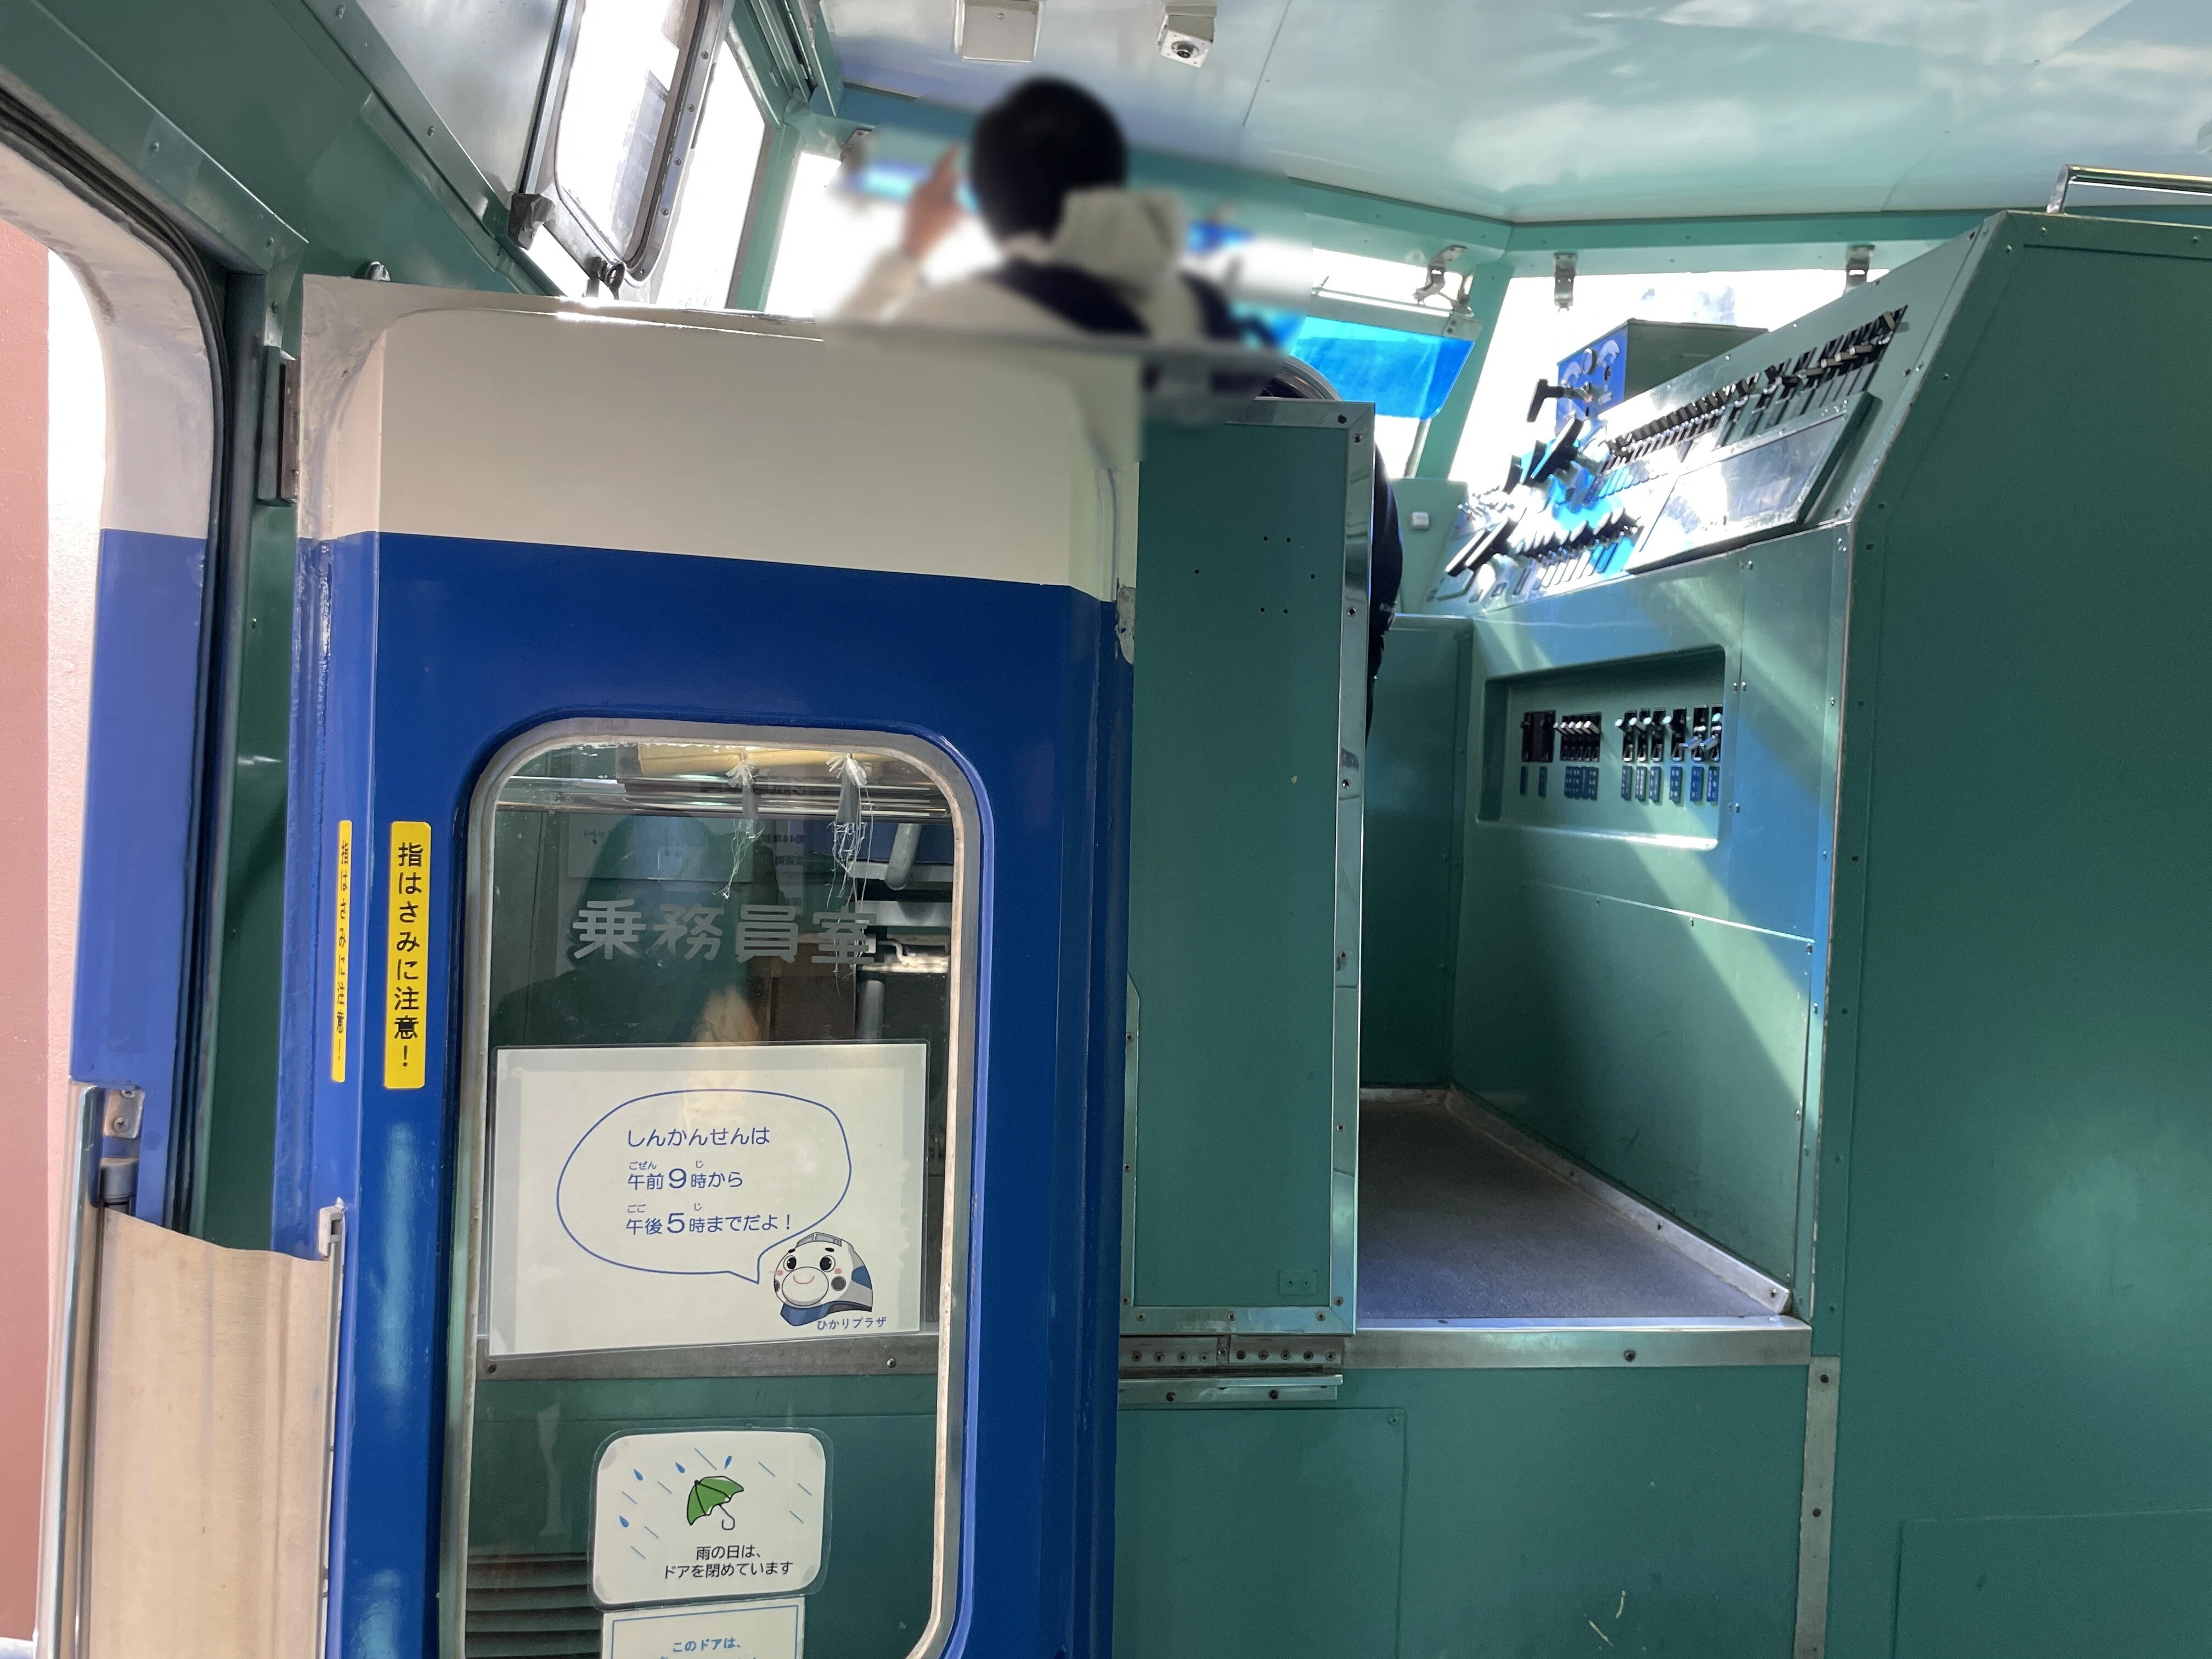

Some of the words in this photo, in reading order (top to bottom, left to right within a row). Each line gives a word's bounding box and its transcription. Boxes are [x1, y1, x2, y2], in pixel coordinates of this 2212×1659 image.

[572, 898, 878, 964] 乗務員室
[394, 842, 424, 1067] 指はさみに注意！
[628, 1126, 770, 1147] しんかんせんは
[629, 1161, 657, 1170] ごぜん
[696, 1160, 704, 1169] じ
[627, 1168, 743, 1190] 午前9時から
[694, 1203, 703, 1211] じ
[626, 1212, 791, 1235] 午後5時までだよ！
[817, 1317, 887, 1330] ひかりプラザ
[696, 1544, 761, 1560] 雨の日は、
[665, 1561, 793, 1579] ドアを閉めています
[673, 1637, 741, 1652] このドアは、
